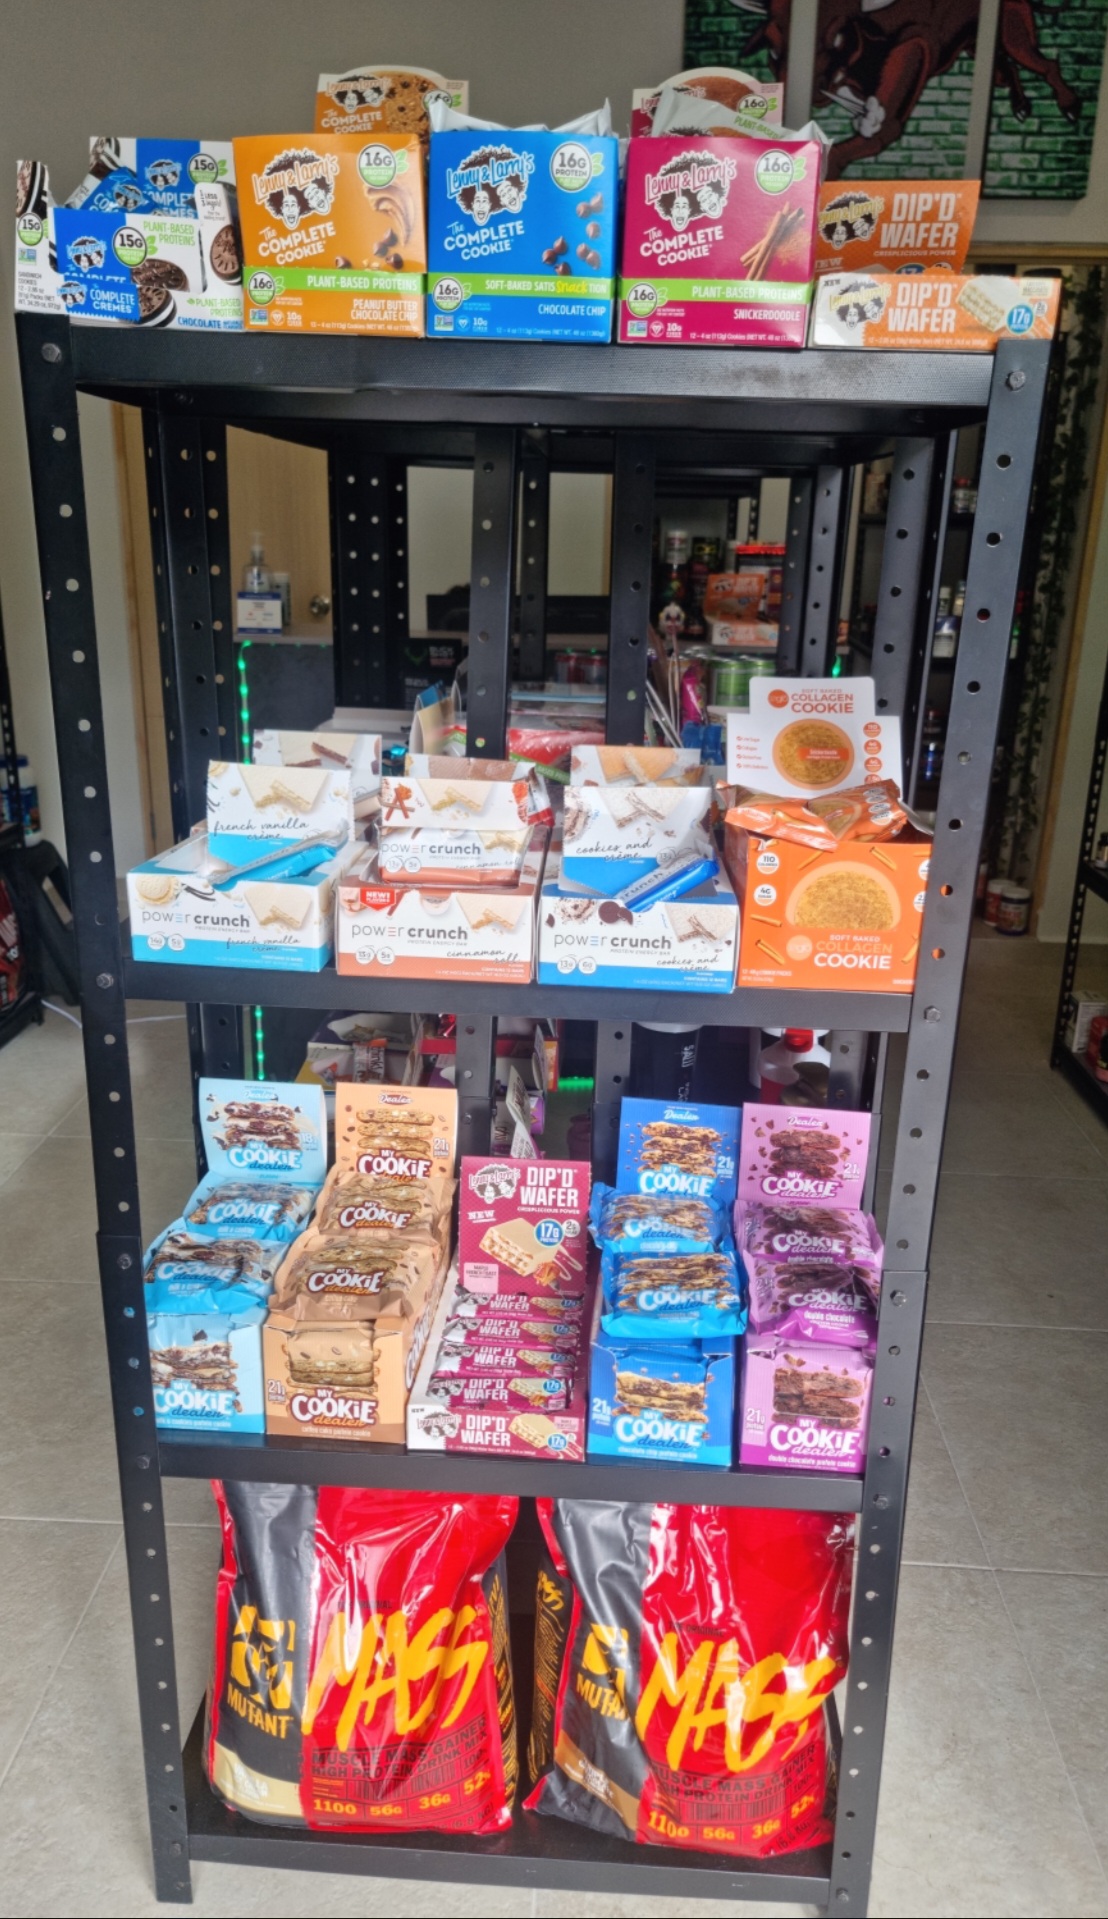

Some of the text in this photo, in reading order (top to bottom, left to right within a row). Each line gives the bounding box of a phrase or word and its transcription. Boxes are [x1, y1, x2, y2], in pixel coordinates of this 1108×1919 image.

[321, 112, 382, 127] COMPLETE
[335, 123, 372, 133] COOKIE
[195, 160, 214, 171] 15G
[366, 152, 392, 166] 16G
[559, 152, 586, 168] 16G
[765, 158, 790, 172] 16G
[23, 219, 40, 230] 15G
[144, 221, 194, 234] PLANT-BASED
[447, 222, 465, 235] The
[159, 235, 195, 246] PROTEINS
[259, 227, 277, 240] The
[259, 222, 335, 257] COMPLETE
[444, 221, 525, 251] COMPLETE
[644, 227, 662, 241] The
[880, 223, 959, 248] WAFER
[120, 234, 143, 248] 15G
[640, 226, 724, 257] COMPLETE
[277, 242, 324, 264] COOKIE
[461, 240, 511, 260] COOKIE
[657, 246, 710, 266] COOKIE
[253, 278, 272, 289] 16G
[307, 275, 417, 291] PLANT-BASED PROTEINS
[438, 284, 459, 295] 16G
[486, 280, 532, 291] SOFT-BAKED
[90, 289, 135, 305] COMPLETE
[634, 290, 654, 301] 16G
[692, 286, 803, 300] PLANT-BASED PROTEINS
[93, 300, 132, 314] CREMES
[354, 300, 417, 311] PEANUT BUTTER
[538, 304, 606, 316] CHOCOLATE CHIP
[351, 310, 418, 322] CHOCOLATE CHIP
[734, 309, 801, 321] SNICKERDOODLE
[888, 308, 957, 333] WAFER
[177, 317, 221, 328] CHOCOLATE
[791, 703, 854, 713] COOKIE
[407, 927, 468, 940] crunch
[610, 935, 671, 949] crunch
[815, 941, 892, 953] COLLAGEN
[814, 954, 892, 969] COOKIE
[527, 1167, 574, 1187] DIP'D
[520, 1187, 578, 1207] WAFER
[468, 1210, 495, 1220] NEW
[318, 1390, 332, 1398] MY
[464, 1389, 508, 1400] WAFER
[314, 1416, 364, 1427] dealer
[466, 1414, 506, 1431] DIP'D
[461, 1430, 511, 1446] WAFER
[638, 1436, 693, 1449] dealer
[768, 1455, 787, 1463] double
[788, 1456, 815, 1465] chocolate
[302, 1605, 489, 1753] MASS
[635, 1631, 837, 1772] MASS
[227, 1682, 291, 1739] MUTANT
[312, 1751, 381, 1765] MUSCLE
[433, 1719, 487, 1754] GAINER
[312, 1765, 347, 1776] HIGH
[418, 1748, 461, 1772] DRINK
[684, 1789, 749, 1802] PROTEIN
[755, 1777, 793, 1801] DRINK
[718, 1777, 766, 1792] MASS
[314, 1800, 357, 1815] 1100
[649, 1811, 690, 1838] 1100
